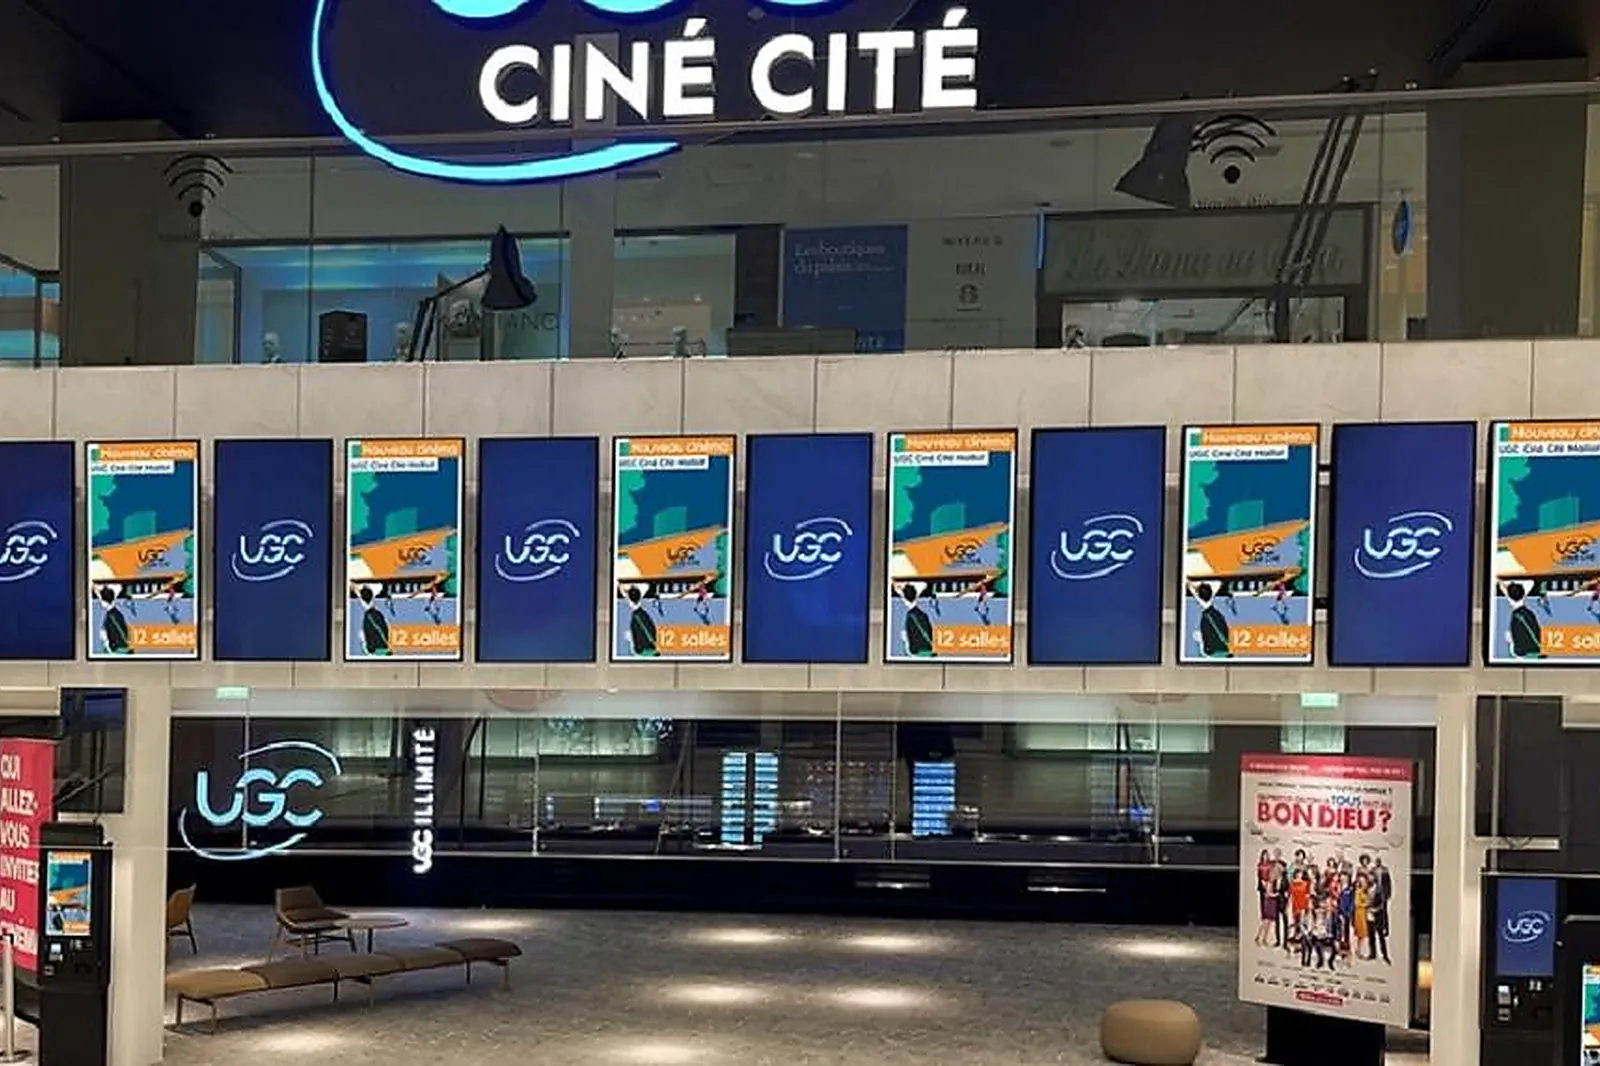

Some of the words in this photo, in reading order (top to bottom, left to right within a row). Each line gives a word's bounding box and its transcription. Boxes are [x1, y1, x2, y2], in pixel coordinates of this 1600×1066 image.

[478, 18, 715, 124] CINÉ
[751, 8, 978, 114] CITÉ
[241, 533, 305, 564] UGC
[505, 533, 570, 564] UGC
[773, 531, 843, 563] UGC
[1060, 529, 1134, 562] UGC
[1363, 527, 1442, 560] UGC
[133, 628, 147, 644] 12
[151, 629, 194, 645] salles
[392, 629, 408, 646] 12
[411, 629, 458, 646] salles
[660, 630, 675, 647] 12
[681, 630, 727, 647] salles
[937, 629, 954, 646] 12
[959, 630, 1007, 647] salles
[1233, 629, 1251, 647] 12
[1255, 630, 1308, 648] salles
[1547, 630, 1565, 648] 12
[412, 728, 436, 826] ILLIMITÉ
[195, 768, 324, 827] UGC
[1257, 801, 1313, 828] BON
[1317, 806, 1376, 832] DIEU
[412, 829, 434, 875] UGC
[1507, 918, 1544, 935] UGC
